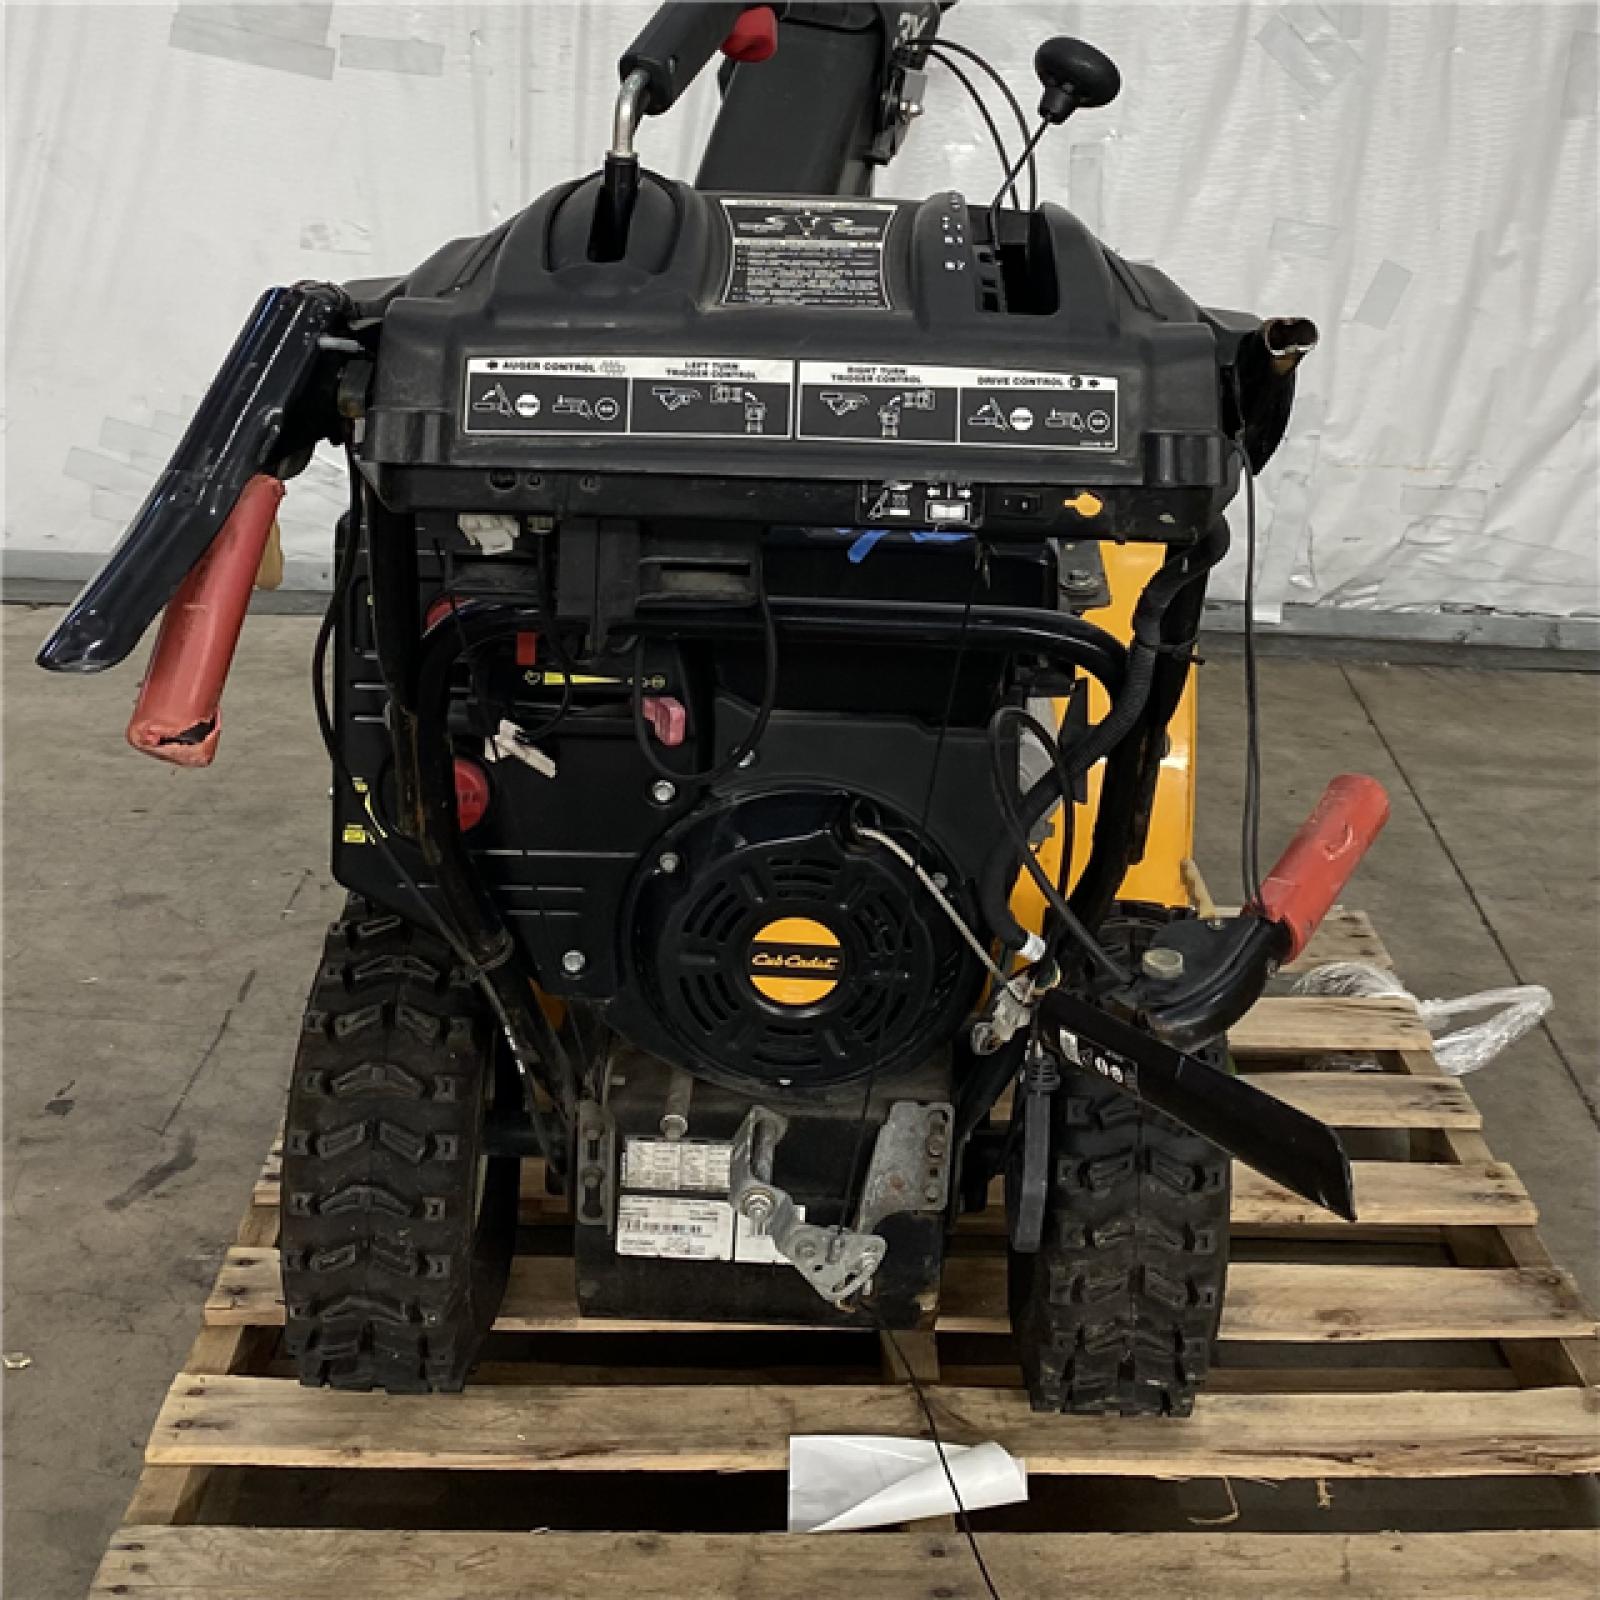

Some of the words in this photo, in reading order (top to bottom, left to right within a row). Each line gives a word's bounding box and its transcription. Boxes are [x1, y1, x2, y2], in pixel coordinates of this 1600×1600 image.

[544, 362, 595, 373] CONTROL
[710, 370, 758, 380] CONTROL
[875, 375, 922, 385] CONTROL
[1013, 376, 1063, 388] CONTROL
[784, 953, 840, 971] Cadet
